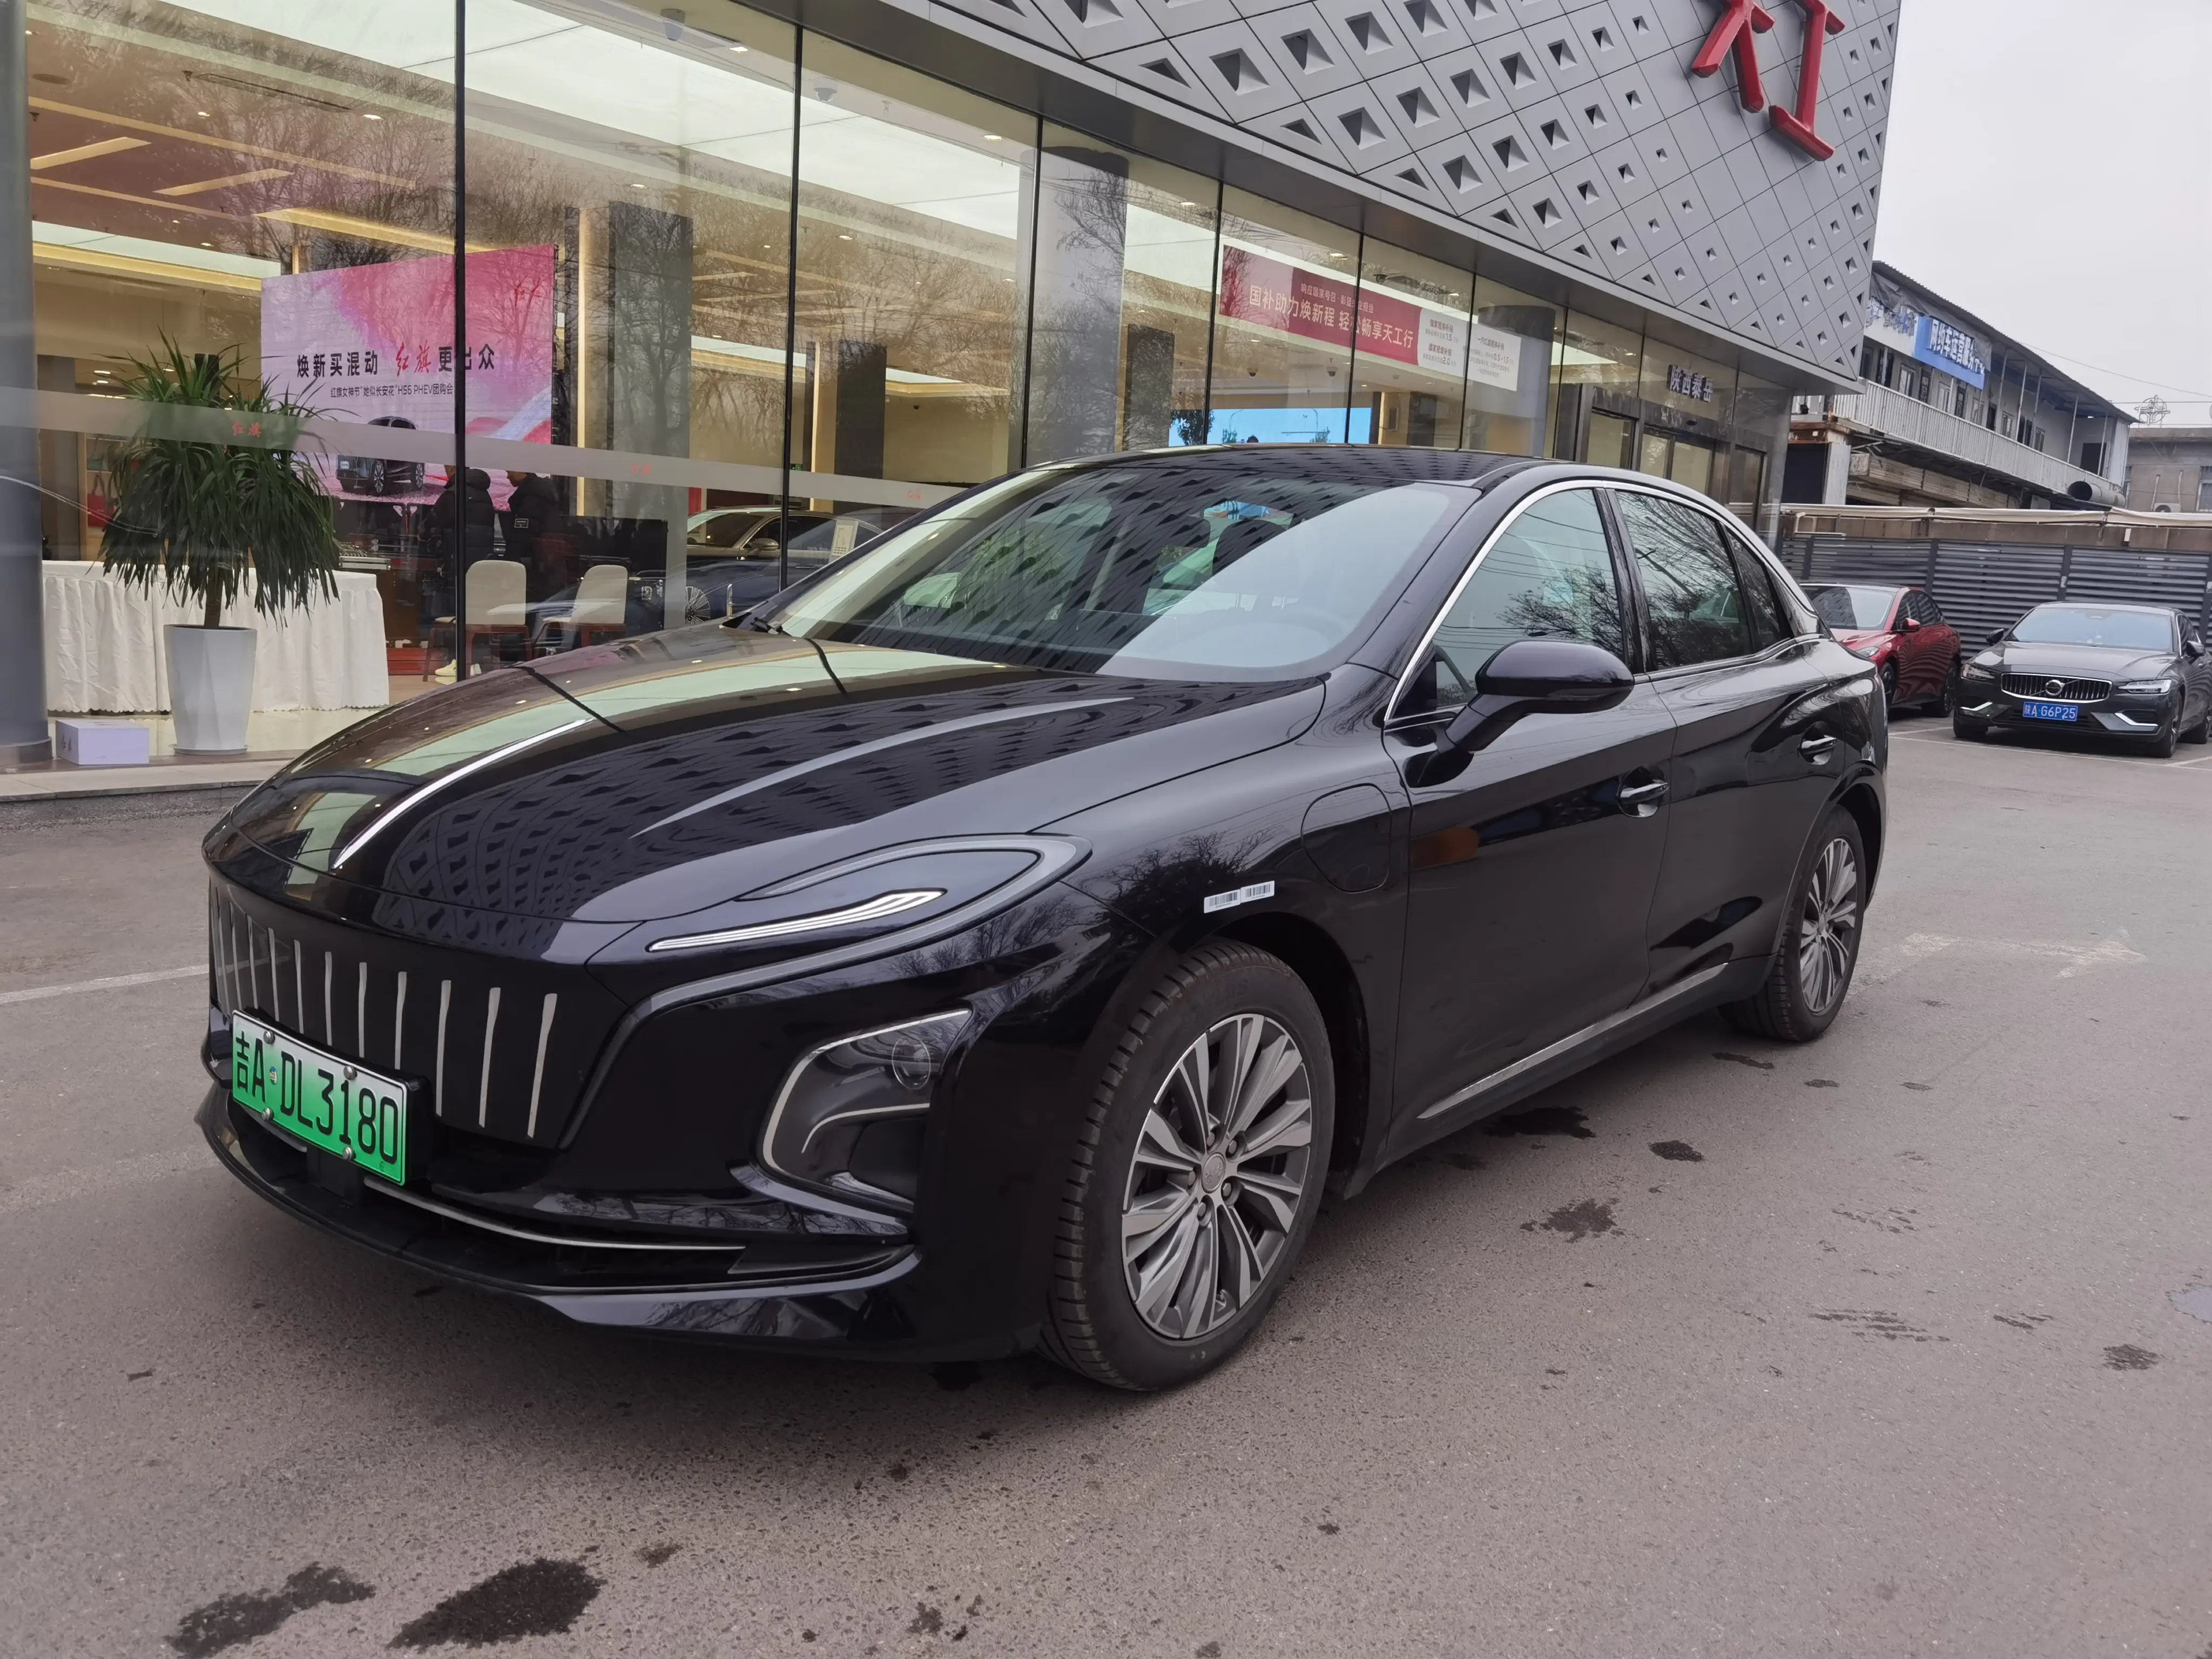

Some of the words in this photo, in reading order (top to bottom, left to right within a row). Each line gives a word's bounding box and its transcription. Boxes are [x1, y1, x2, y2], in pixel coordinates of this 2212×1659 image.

[1249, 285, 1336, 327] 国补助力焕新程
[1338, 310, 1414, 348] 轻松畅享天工行
[1300, 283, 1374, 314] 响应国家号召·彰显企担当
[297, 350, 377, 378] 焕新买混动
[395, 340, 431, 377] 红旗
[414, 383, 453, 395] PHEV团购会
[1670, 365, 1713, 403] 陕西泰岳
